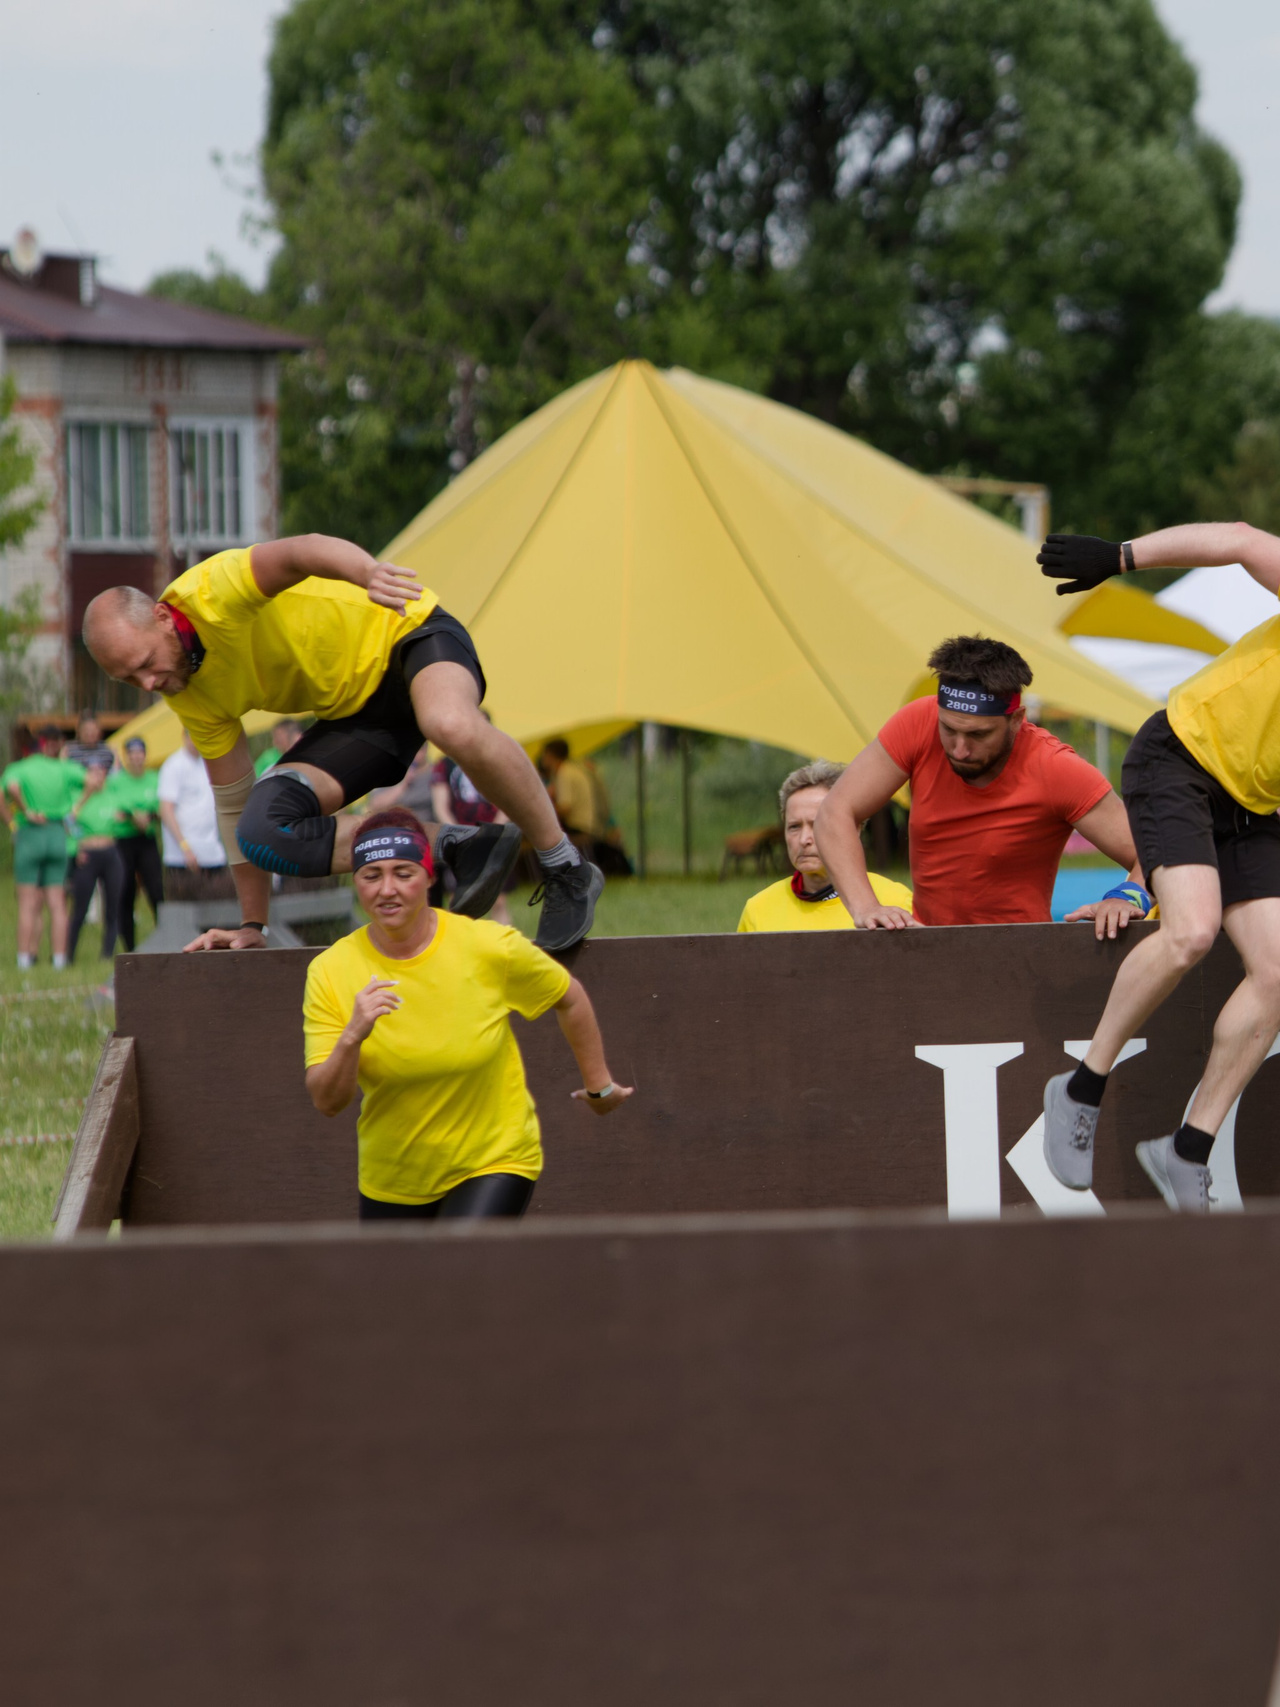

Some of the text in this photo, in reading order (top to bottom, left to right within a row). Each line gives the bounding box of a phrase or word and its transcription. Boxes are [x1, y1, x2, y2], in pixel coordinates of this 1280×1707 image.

[940, 684, 995, 702] РОДЕО 59
[946, 700, 978, 713] 2809
[354, 836, 411, 854] РОДЕО 59
[364, 848, 395, 862] 2808
